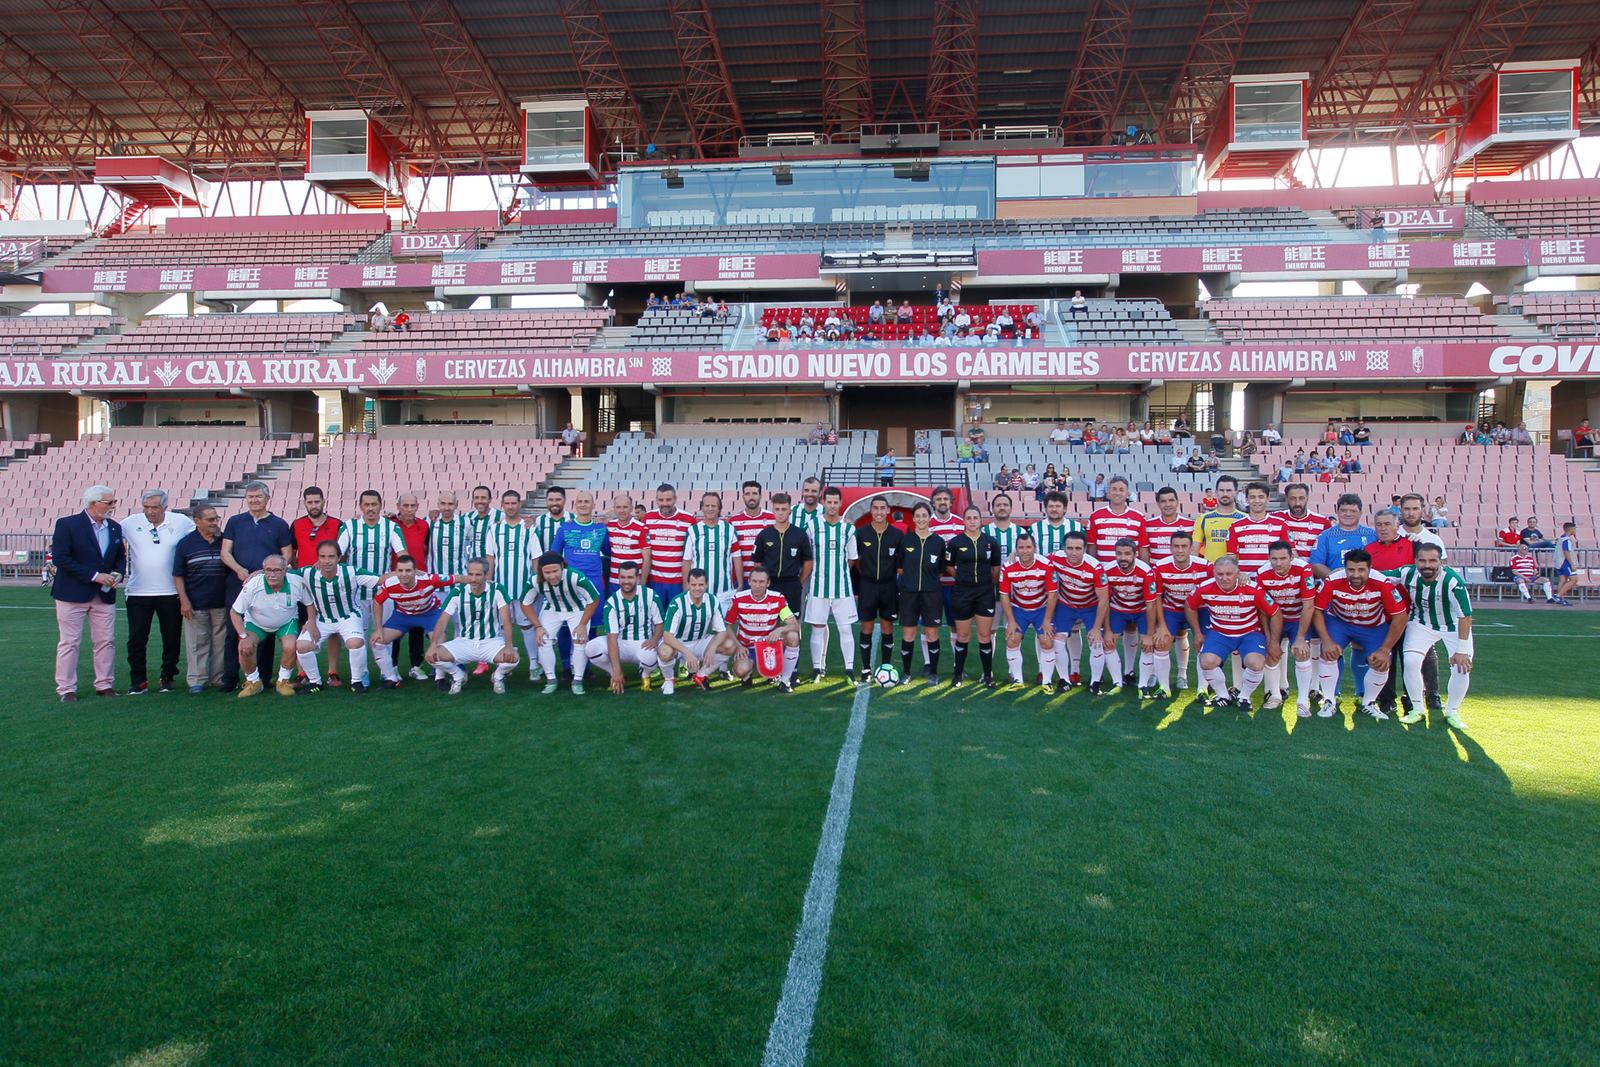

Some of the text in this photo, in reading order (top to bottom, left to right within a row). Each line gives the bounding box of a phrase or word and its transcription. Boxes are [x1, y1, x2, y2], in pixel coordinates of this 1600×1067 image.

[1372, 209, 1453, 227] DEAL
[400, 234, 466, 249] IDEAL
[51, 361, 150, 385] RURAL
[185, 358, 365, 385] CAJA RURAL
[444, 357, 643, 379] CERVEZAS ALHAMBRA SIN
[698, 348, 1100, 379] ESTADIO NUEVO LOS CÁRMENES
[1128, 350, 1356, 373] CERVEZAS ALHAMBRA SIN
